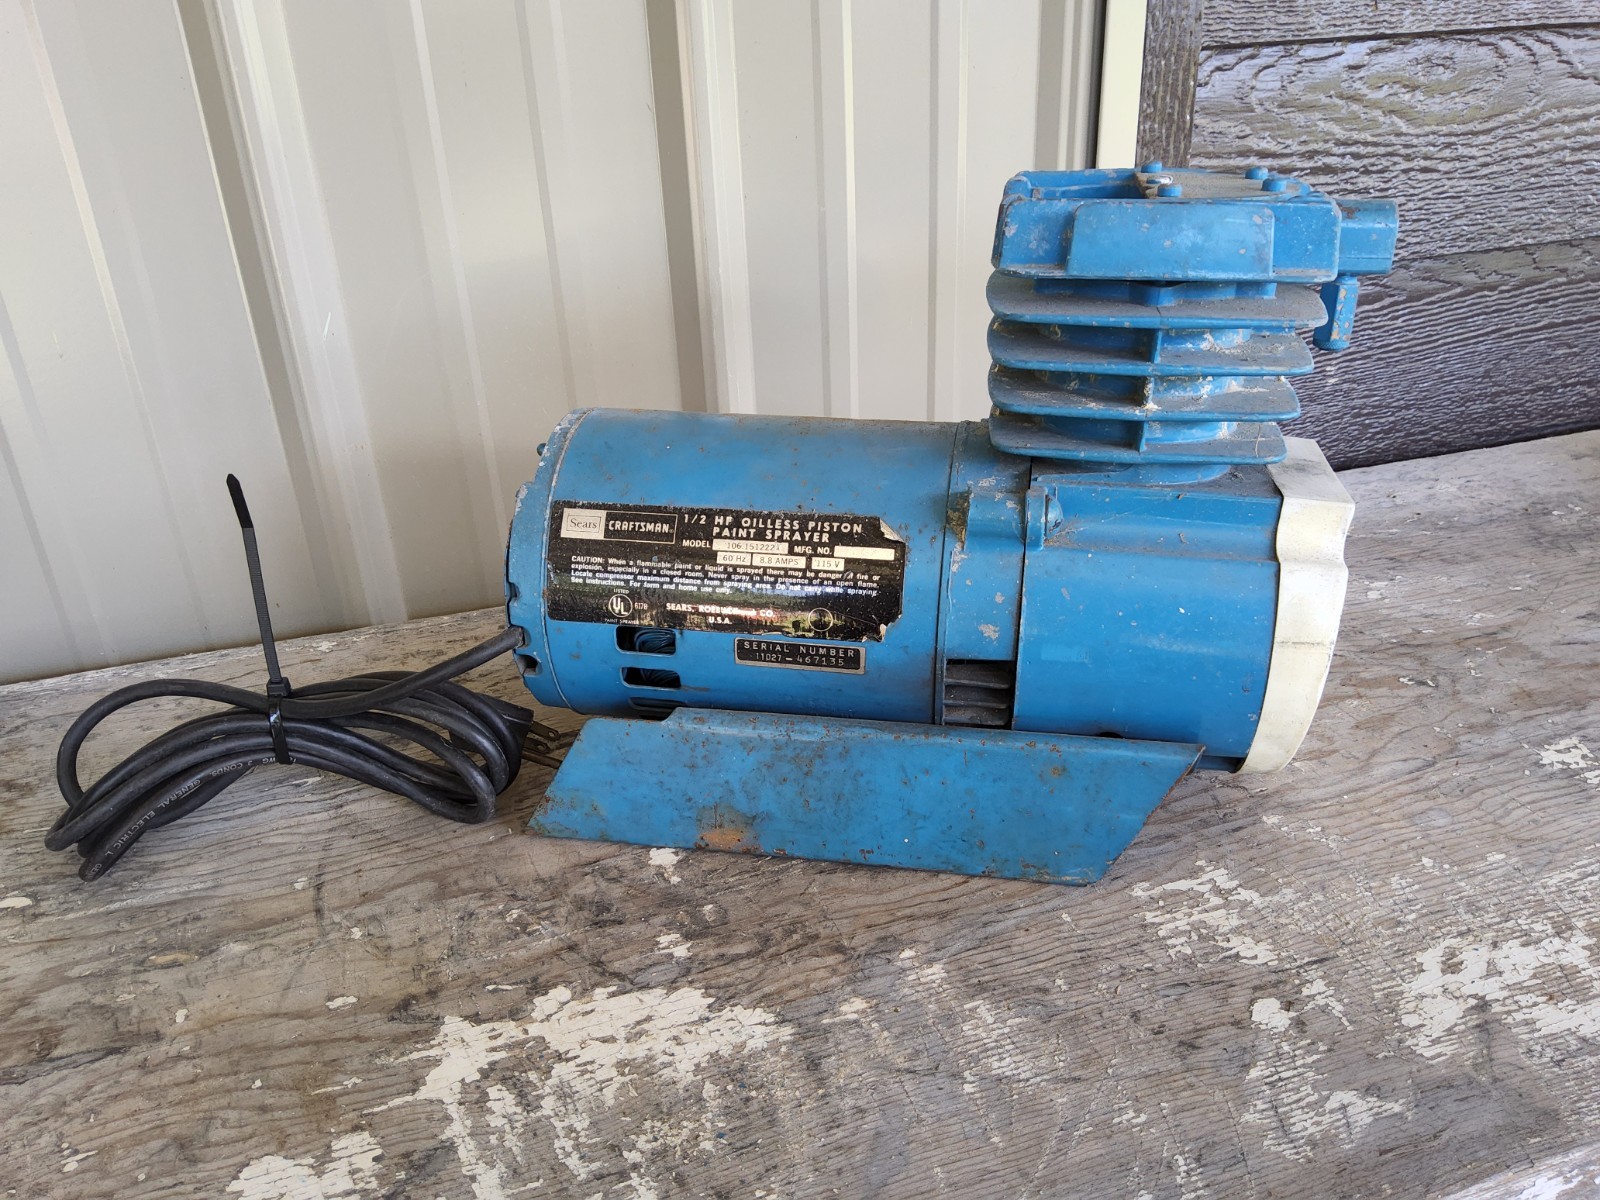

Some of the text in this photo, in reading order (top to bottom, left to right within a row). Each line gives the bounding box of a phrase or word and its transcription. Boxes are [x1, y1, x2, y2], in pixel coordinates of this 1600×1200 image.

[569, 518, 598, 529] Sears
[608, 520, 669, 533] CRAFTSMAN
[684, 514, 863, 533] 1/2 HP OILLESS PISTON
[712, 526, 830, 543] PAINT SPRAYER
[682, 539, 711, 548] MODEL
[793, 545, 814, 554] MFG.
[817, 546, 832, 555] NO.
[571, 555, 605, 564] CAUTION:
[607, 557, 627, 566] When
[636, 559, 671, 568] flammable
[674, 563, 691, 572] paint
[705, 564, 724, 574] liquid
[736, 567, 763, 577] sprayed
[767, 568, 784, 576] there
[788, 570, 803, 578] may
[818, 571, 842, 580] danger
[722, 554, 840, 568] 60 Hz 8.8 AMPS 115 V
[571, 564, 604, 572] explosion,
[607, 566, 640, 574] especially
[660, 568, 682, 576] closed
[731, 574, 750, 582] spray
[836, 580, 853, 588] open
[571, 570, 593, 578] Locate
[673, 577, 702, 585] distance
[723, 581, 752, 589] spraying
[804, 586, 821, 594] carry
[847, 588, 878, 597] spraying.
[586, 578, 626, 586] instructions.
[679, 584, 697, 592] home
[715, 587, 733, 595] only.
[612, 597, 628, 615] UL
[708, 616, 733, 625] U.S.A.
[743, 640, 855, 658] SERIAL NUMBER
[157, 779, 202, 809] GENERAL
[112, 810, 156, 850] ELECTRIC
